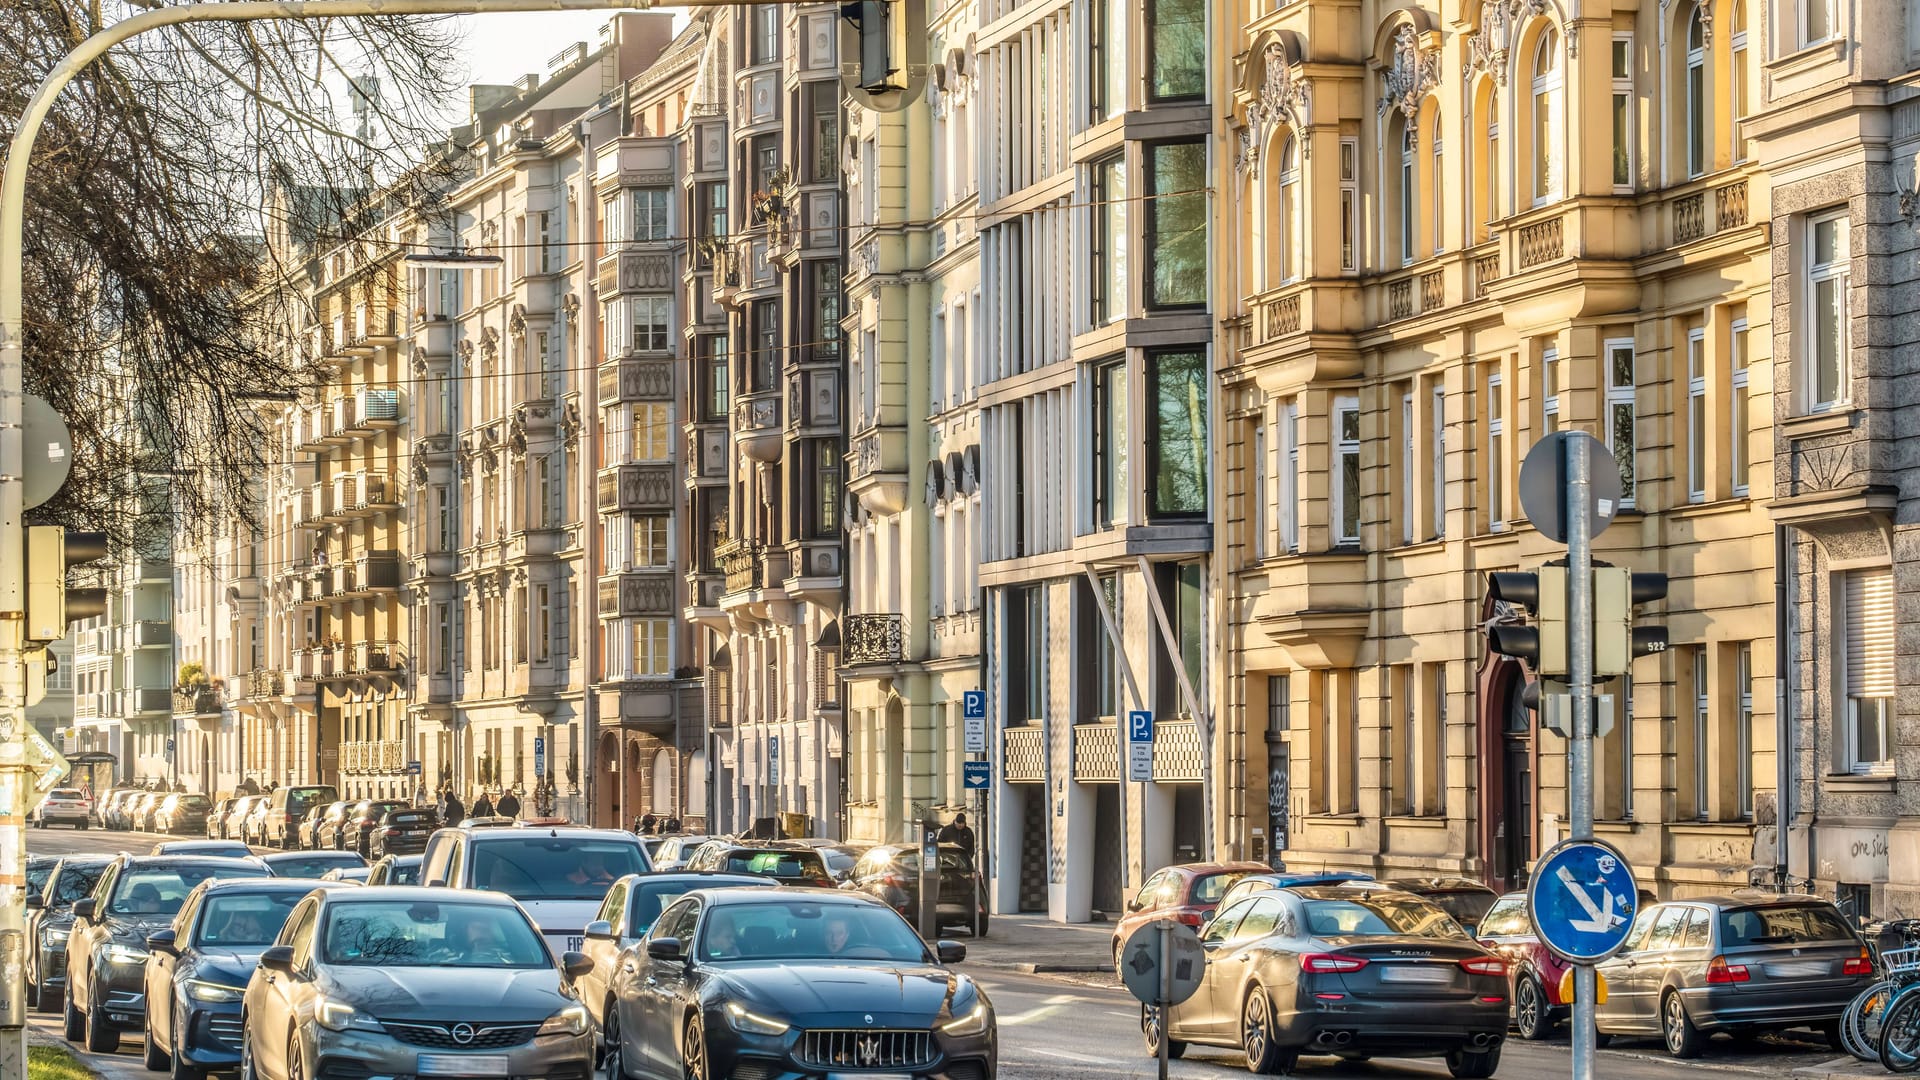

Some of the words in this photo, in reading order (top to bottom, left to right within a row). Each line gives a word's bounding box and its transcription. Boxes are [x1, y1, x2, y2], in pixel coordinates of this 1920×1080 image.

[1647, 641, 1665, 651] 522
[967, 694, 979, 715] P
[1132, 714, 1146, 738] P
[927, 832, 935, 842] P
